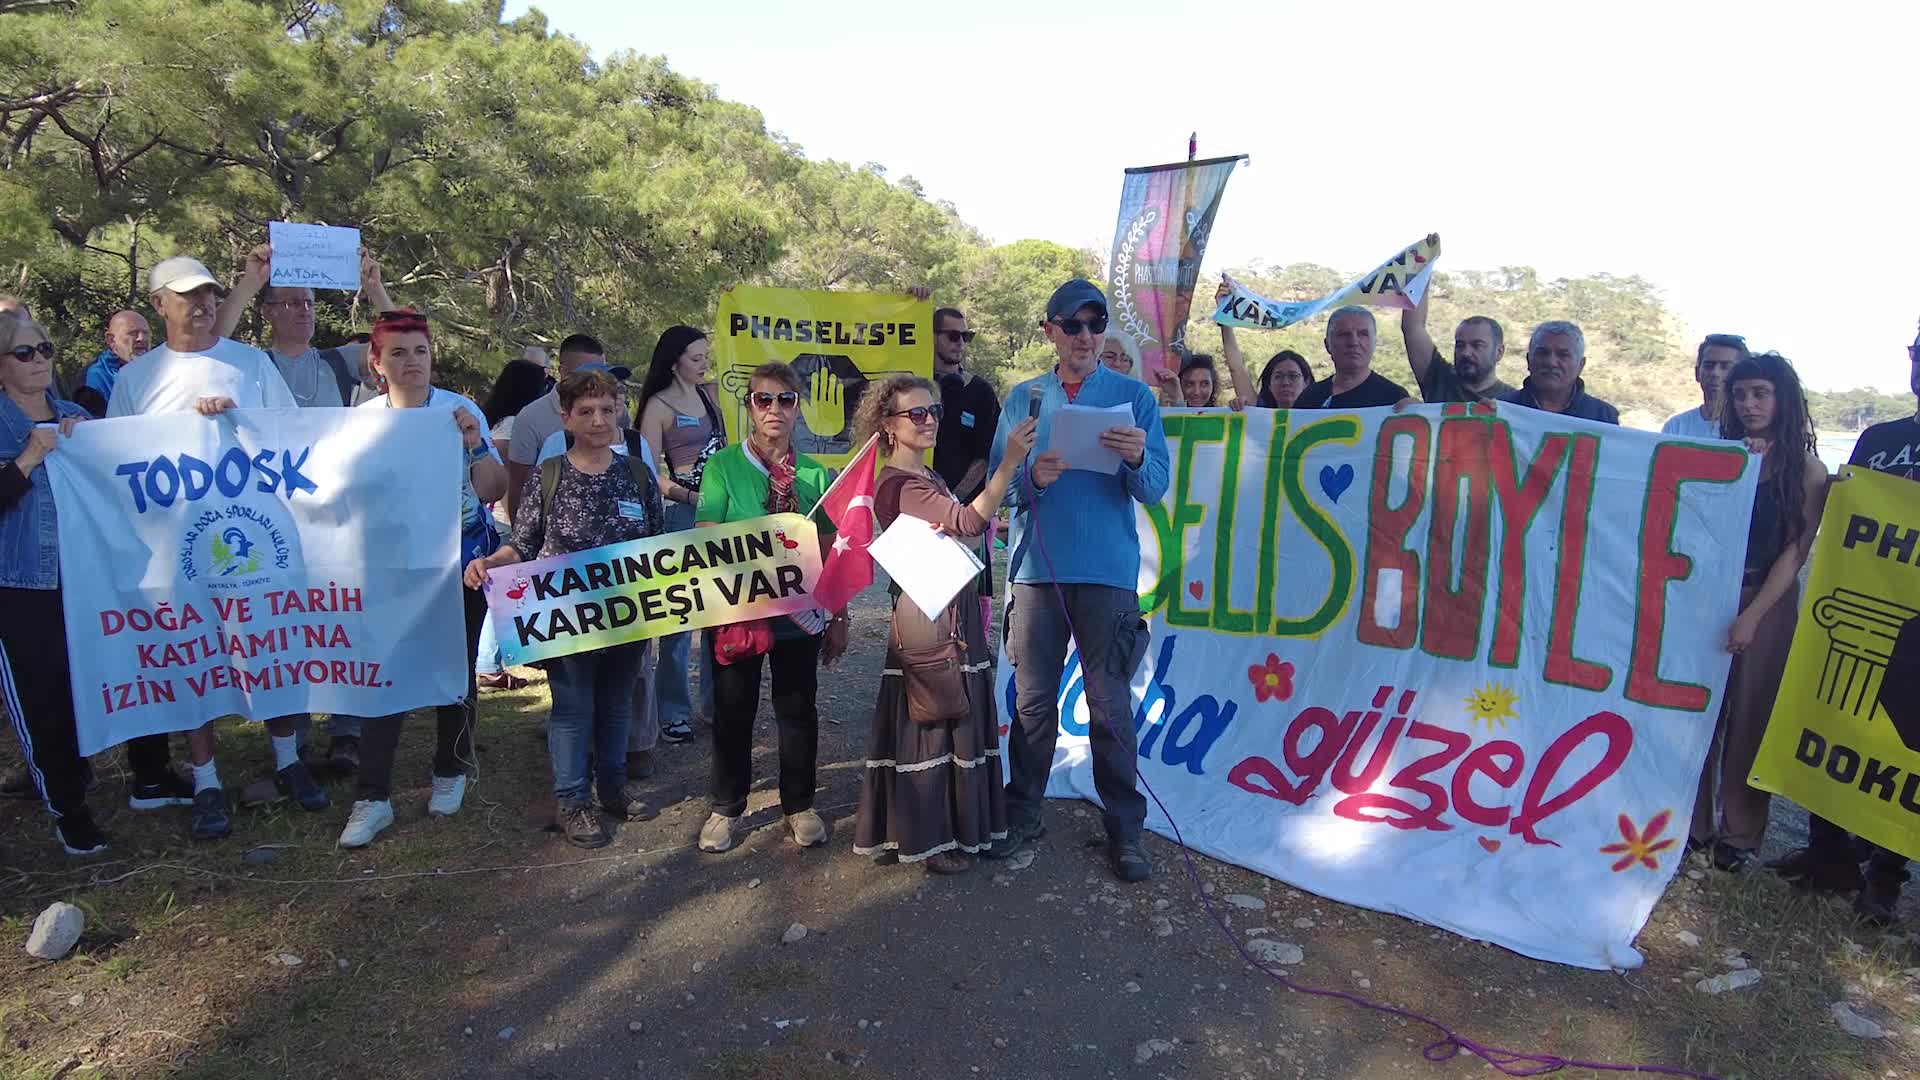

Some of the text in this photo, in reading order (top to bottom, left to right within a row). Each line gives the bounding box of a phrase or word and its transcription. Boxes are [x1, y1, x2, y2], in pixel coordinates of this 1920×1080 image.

[730, 313, 916, 346] PHASELIS'E
[116, 446, 318, 514] TODOSK
[530, 530, 774, 601] KARINCANIN
[1356, 402, 1749, 712] BÖYLE
[1842, 513, 1920, 568] PH
[99, 581, 363, 636] DOĞA VE TARİH
[713, 565, 807, 606] VAR
[136, 624, 352, 669] KATLİAMI'NA
[101, 659, 393, 714] İZİN VERMİYORUZ.
[1226, 685, 1634, 848] güzel
